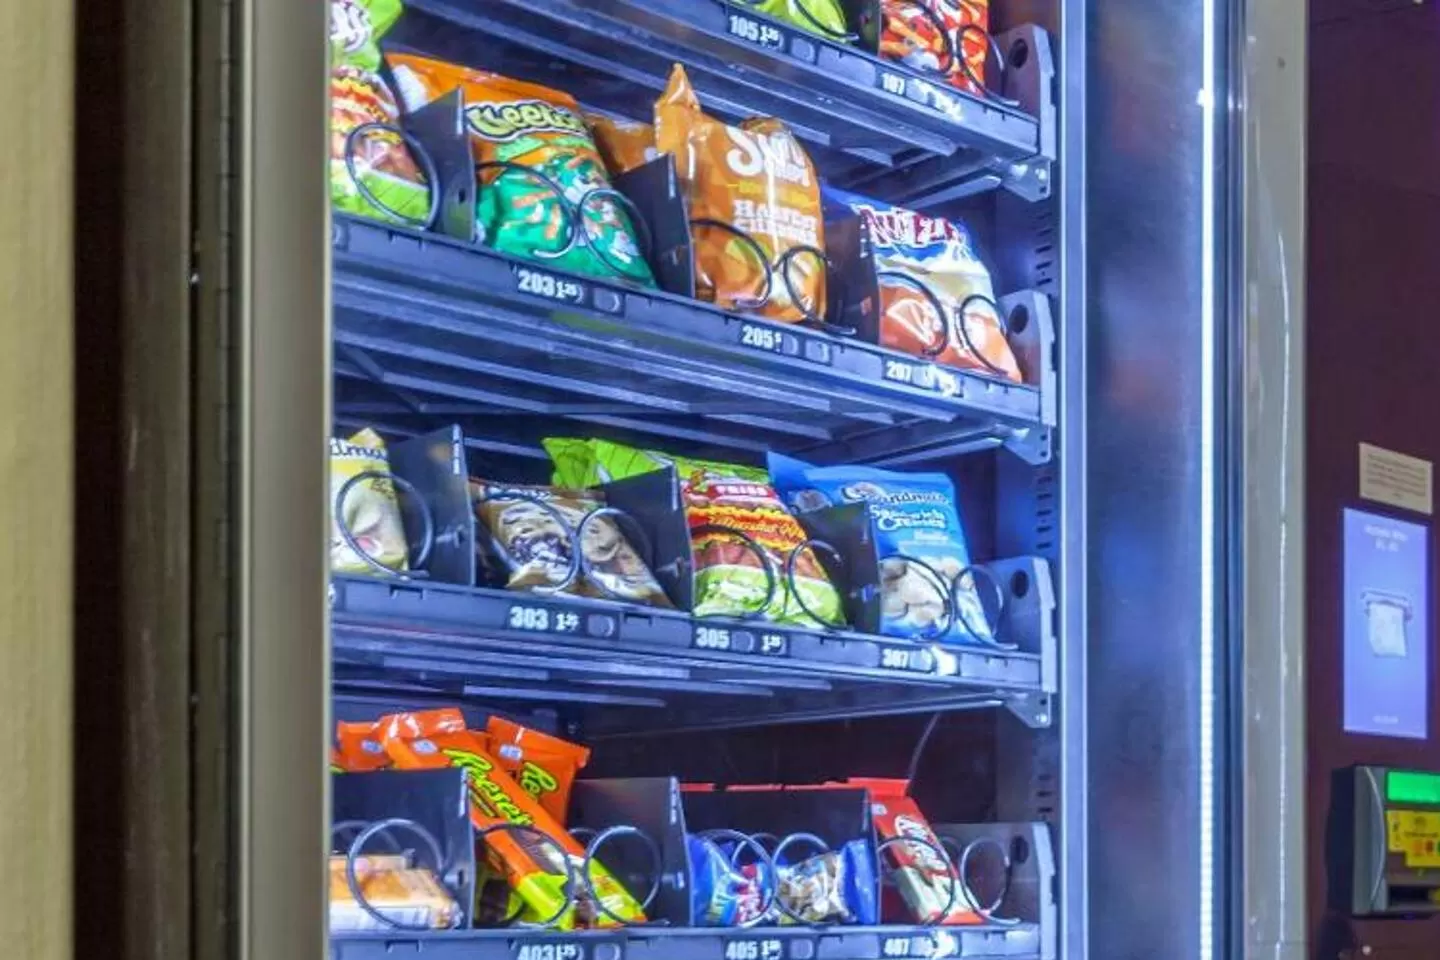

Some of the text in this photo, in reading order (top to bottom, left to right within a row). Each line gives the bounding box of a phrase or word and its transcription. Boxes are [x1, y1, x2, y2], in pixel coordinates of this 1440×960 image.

[729, 14, 759, 41] 105
[518, 269, 555, 297] 203
[742, 325, 774, 350] 205
[510, 605, 549, 631] 303
[696, 626, 730, 649] 305
[725, 939, 757, 960] 405
